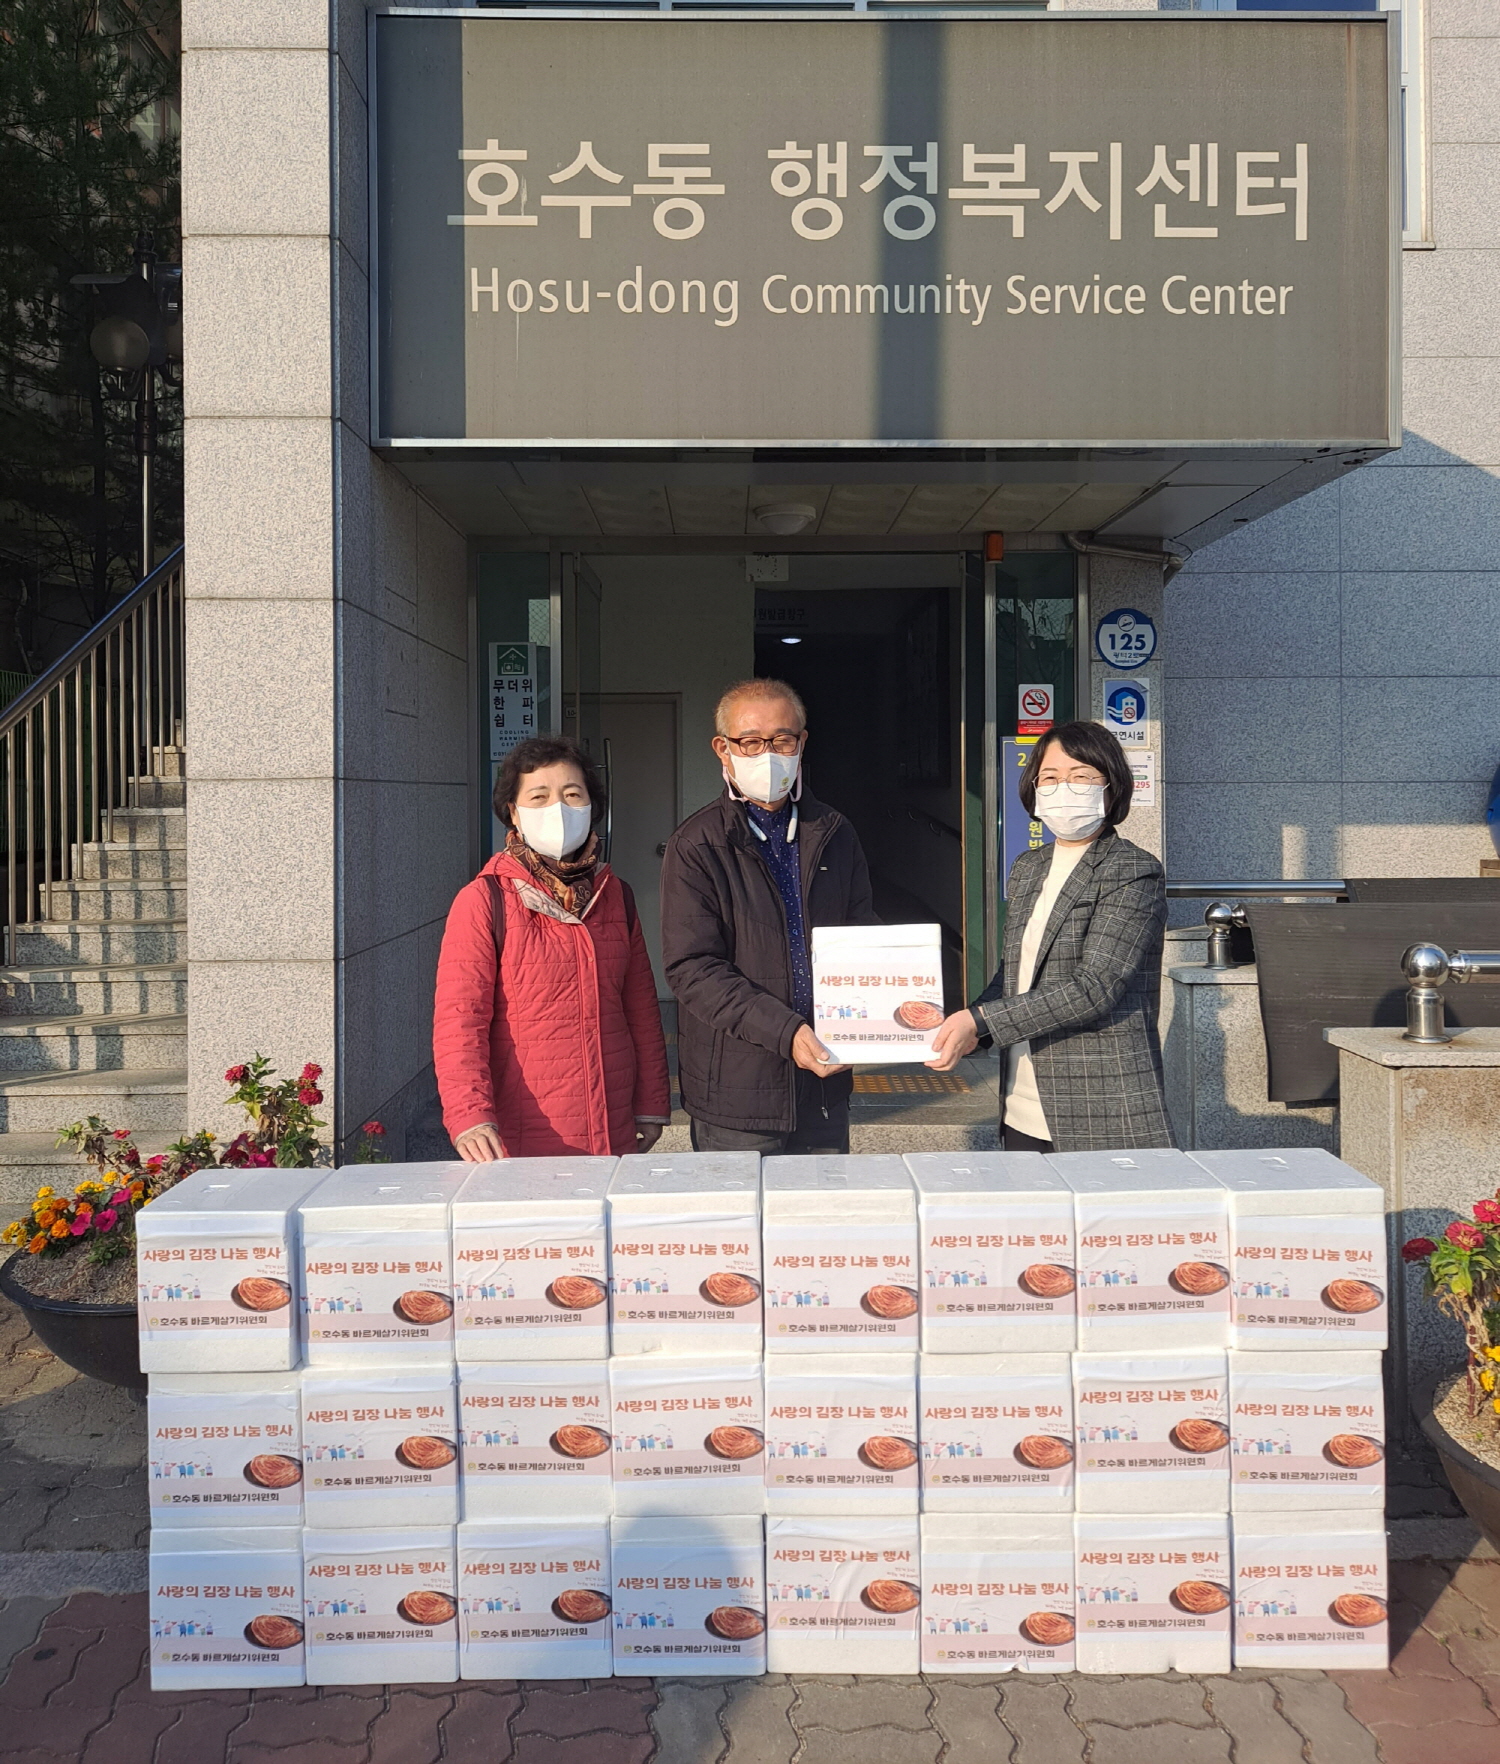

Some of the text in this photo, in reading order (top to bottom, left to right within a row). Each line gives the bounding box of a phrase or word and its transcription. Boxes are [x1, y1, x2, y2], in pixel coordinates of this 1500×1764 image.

[447, 139, 1309, 242] 호수동 행정복지센터
[470, 266, 1294, 327] Hosu-dong Community Service Center
[1108, 633, 1146, 650] 125
[493, 679, 533, 693] 무더위
[1133, 781, 1151, 789] 295
[820, 976, 936, 986] 사랑의 김장 나눔 행사
[931, 1235, 1068, 1248] 사랑의 김장 나눔 행사
[1081, 1233, 1217, 1247] 사랑의 김장 나눔 행사
[144, 1247, 280, 1262] 사랑의 김장 나눔 행사
[457, 1247, 594, 1262] 사랑의 김장 나눔 행사
[612, 1244, 749, 1255] 사랑의 김장 나눔 행사
[1235, 1247, 1276, 1259] 사랑의
[1280, 1248, 1308, 1260] 김장
[1313, 1249, 1340, 1261] 나눔
[1345, 1250, 1372, 1262] 행사
[306, 1261, 443, 1274] 사랑의 김장 나눔 행사
[773, 1256, 910, 1268] 사랑의 김장 나눔 행사
[1098, 1303, 1125, 1311] 호수동
[475, 1316, 502, 1325] 호수동
[1248, 1315, 1275, 1323] 호수동
[323, 1330, 350, 1338] 호수동
[463, 1396, 600, 1408] 사랑의 김장 나눔 행사
[1080, 1389, 1218, 1404] 사랑의 김장 나눔 행사
[616, 1397, 752, 1412] 사랑의 김장 나눔 행사
[1236, 1404, 1277, 1416] 사랑의
[1282, 1405, 1310, 1416] 김장
[1314, 1405, 1342, 1416] 나눔
[1346, 1406, 1374, 1417] 행사
[307, 1407, 444, 1422] 사랑의 김장 나눔 행사
[770, 1407, 811, 1419] 사랑의
[816, 1407, 844, 1418] 김장
[848, 1407, 875, 1418] 나눔
[880, 1406, 908, 1418] 행사
[925, 1406, 1063, 1419] 사랑의 김장 나눔 행사
[156, 1425, 293, 1439] 사랑의 김장 나눔 행사
[634, 1467, 661, 1476] 호수동
[325, 1478, 352, 1486] 호수동
[943, 1475, 969, 1483] 호수동
[774, 1550, 911, 1562] 사랑의 김장 나눔 행사
[1081, 1552, 1219, 1564] 사랑의 김장 나눔 행사
[309, 1562, 446, 1577] 사랑의 김장 나눔 행사
[464, 1560, 600, 1575] 사랑의 김장 나눔 행사
[1239, 1566, 1280, 1578] 사랑의
[1285, 1566, 1313, 1577] 김장
[1317, 1565, 1345, 1577] 나눔
[1350, 1565, 1377, 1576] 행사
[618, 1578, 658, 1589] 사랑의
[663, 1578, 690, 1589] 김장
[695, 1577, 722, 1589] 나눔
[727, 1577, 754, 1588] 행사
[932, 1583, 1069, 1595] 사랑의 김장 나눔 행사
[157, 1586, 295, 1598] 사랑의 김장 나눔 행사
[1098, 1620, 1125, 1628] 호수동
[481, 1630, 508, 1638] 호수동
